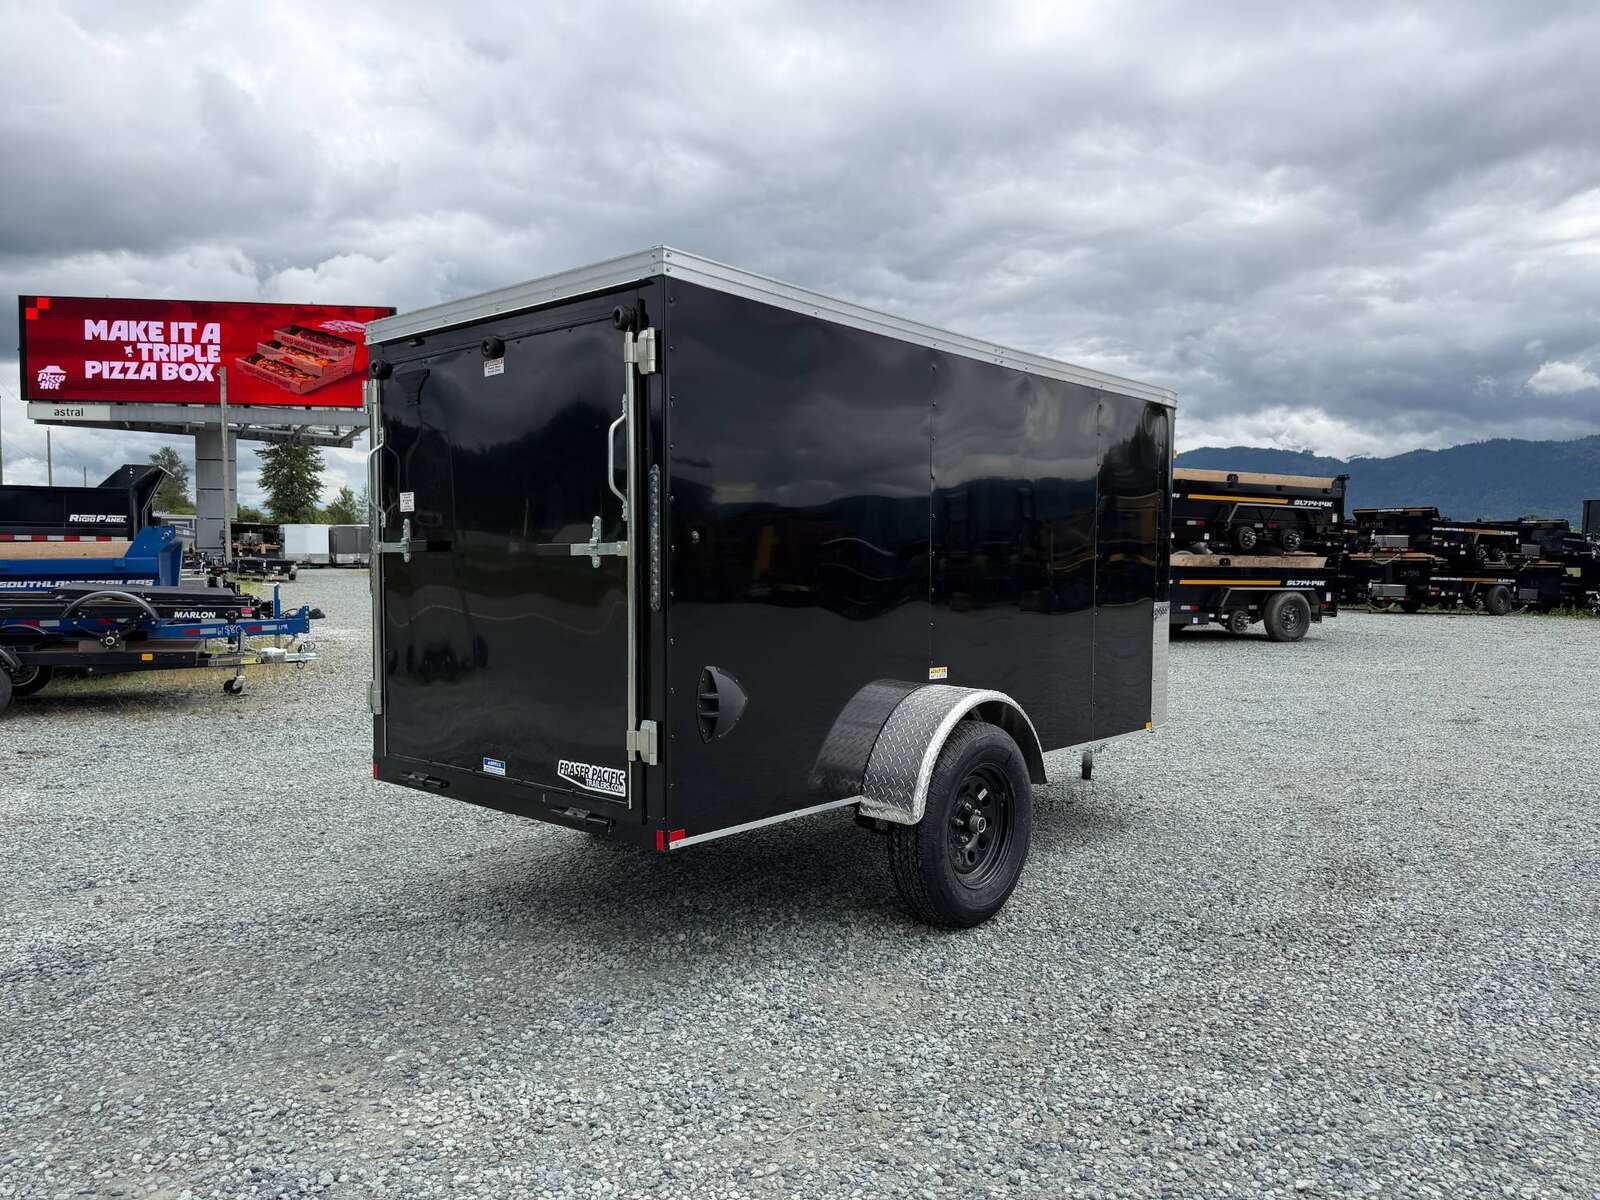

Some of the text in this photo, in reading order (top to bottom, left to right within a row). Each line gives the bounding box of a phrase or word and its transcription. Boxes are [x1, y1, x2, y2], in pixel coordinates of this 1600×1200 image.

[84, 319, 220, 344] MAKE IT A
[137, 342, 220, 362] TRIPLE
[84, 360, 215, 382] PIZZA BOX
[37, 372, 66, 383] Pizza
[39, 381, 61, 390] Hut
[54, 407, 84, 417] astral
[0, 580, 85, 588] SOUTHLA
[173, 611, 216, 619] MARLON
[560, 762, 625, 786] FRASER PACIFIC
[586, 779, 625, 793] TRAILERS.COM
